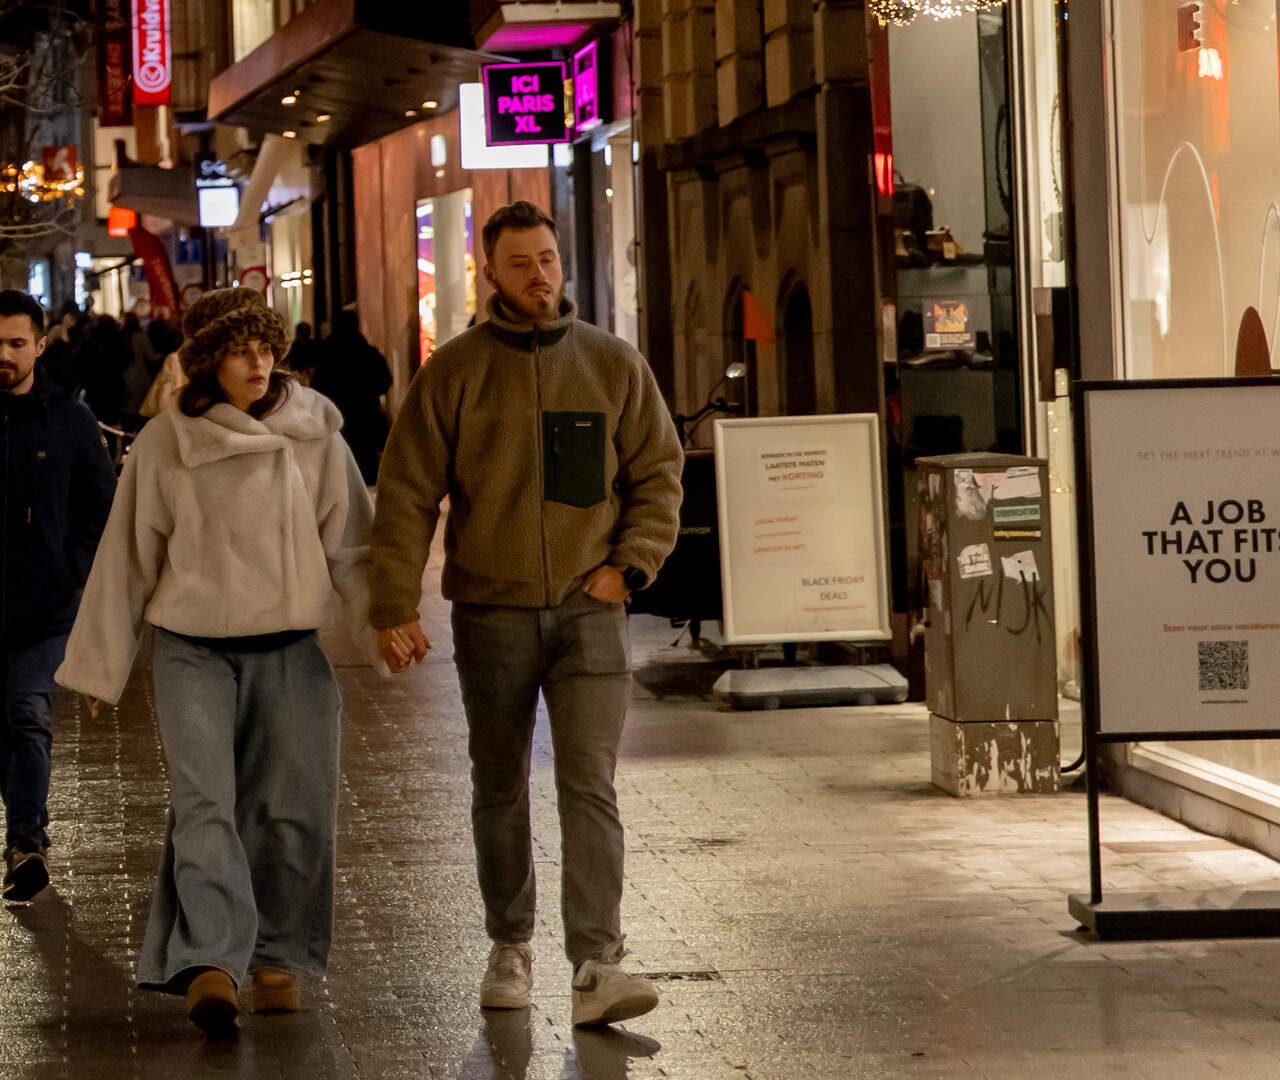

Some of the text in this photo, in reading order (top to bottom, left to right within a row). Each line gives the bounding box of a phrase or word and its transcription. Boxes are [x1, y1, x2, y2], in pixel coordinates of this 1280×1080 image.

[511, 74, 539, 94] ICI
[497, 93, 555, 114] PARIS
[514, 114, 542, 133] XL
[1159, 450, 1178, 461] THE
[1183, 449, 1211, 459] NEXT
[1215, 448, 1250, 459] TREND
[1169, 498, 1266, 526] A JOB
[1141, 529, 1224, 556] THAT
[1182, 557, 1256, 584] YOU
[801, 575, 865, 587] BLACK FRIDAY
[820, 591, 849, 601] DEALS
